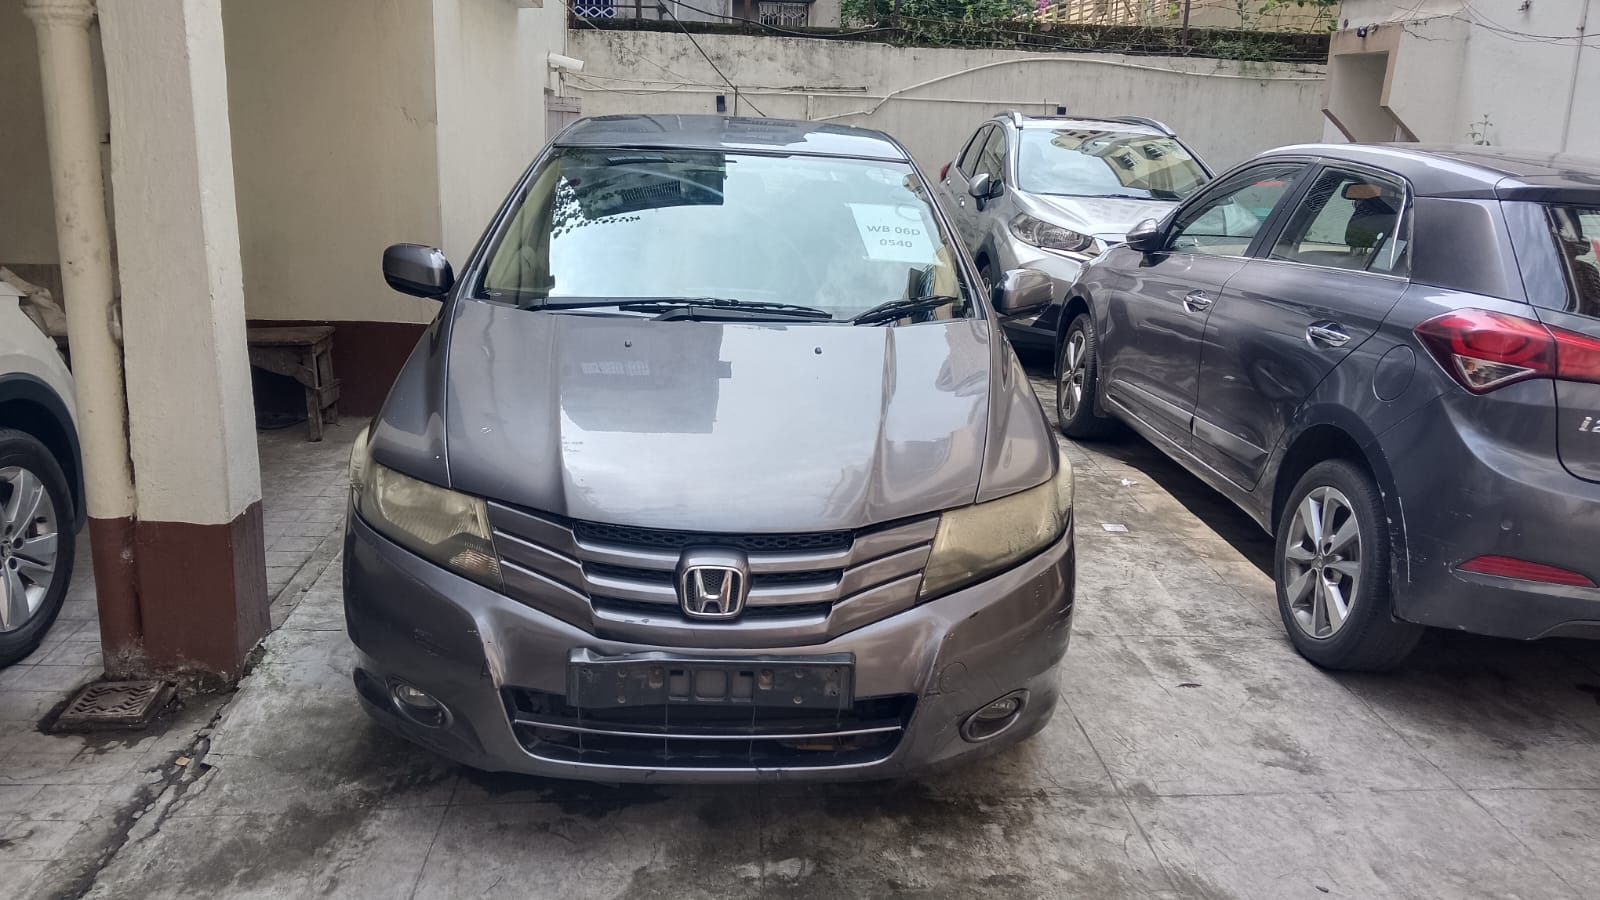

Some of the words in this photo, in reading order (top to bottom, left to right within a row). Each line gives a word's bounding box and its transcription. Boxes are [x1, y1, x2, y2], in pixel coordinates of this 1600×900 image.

[867, 225, 890, 233] WB
[894, 226, 920, 236] 06D
[880, 238, 912, 248] 0540
